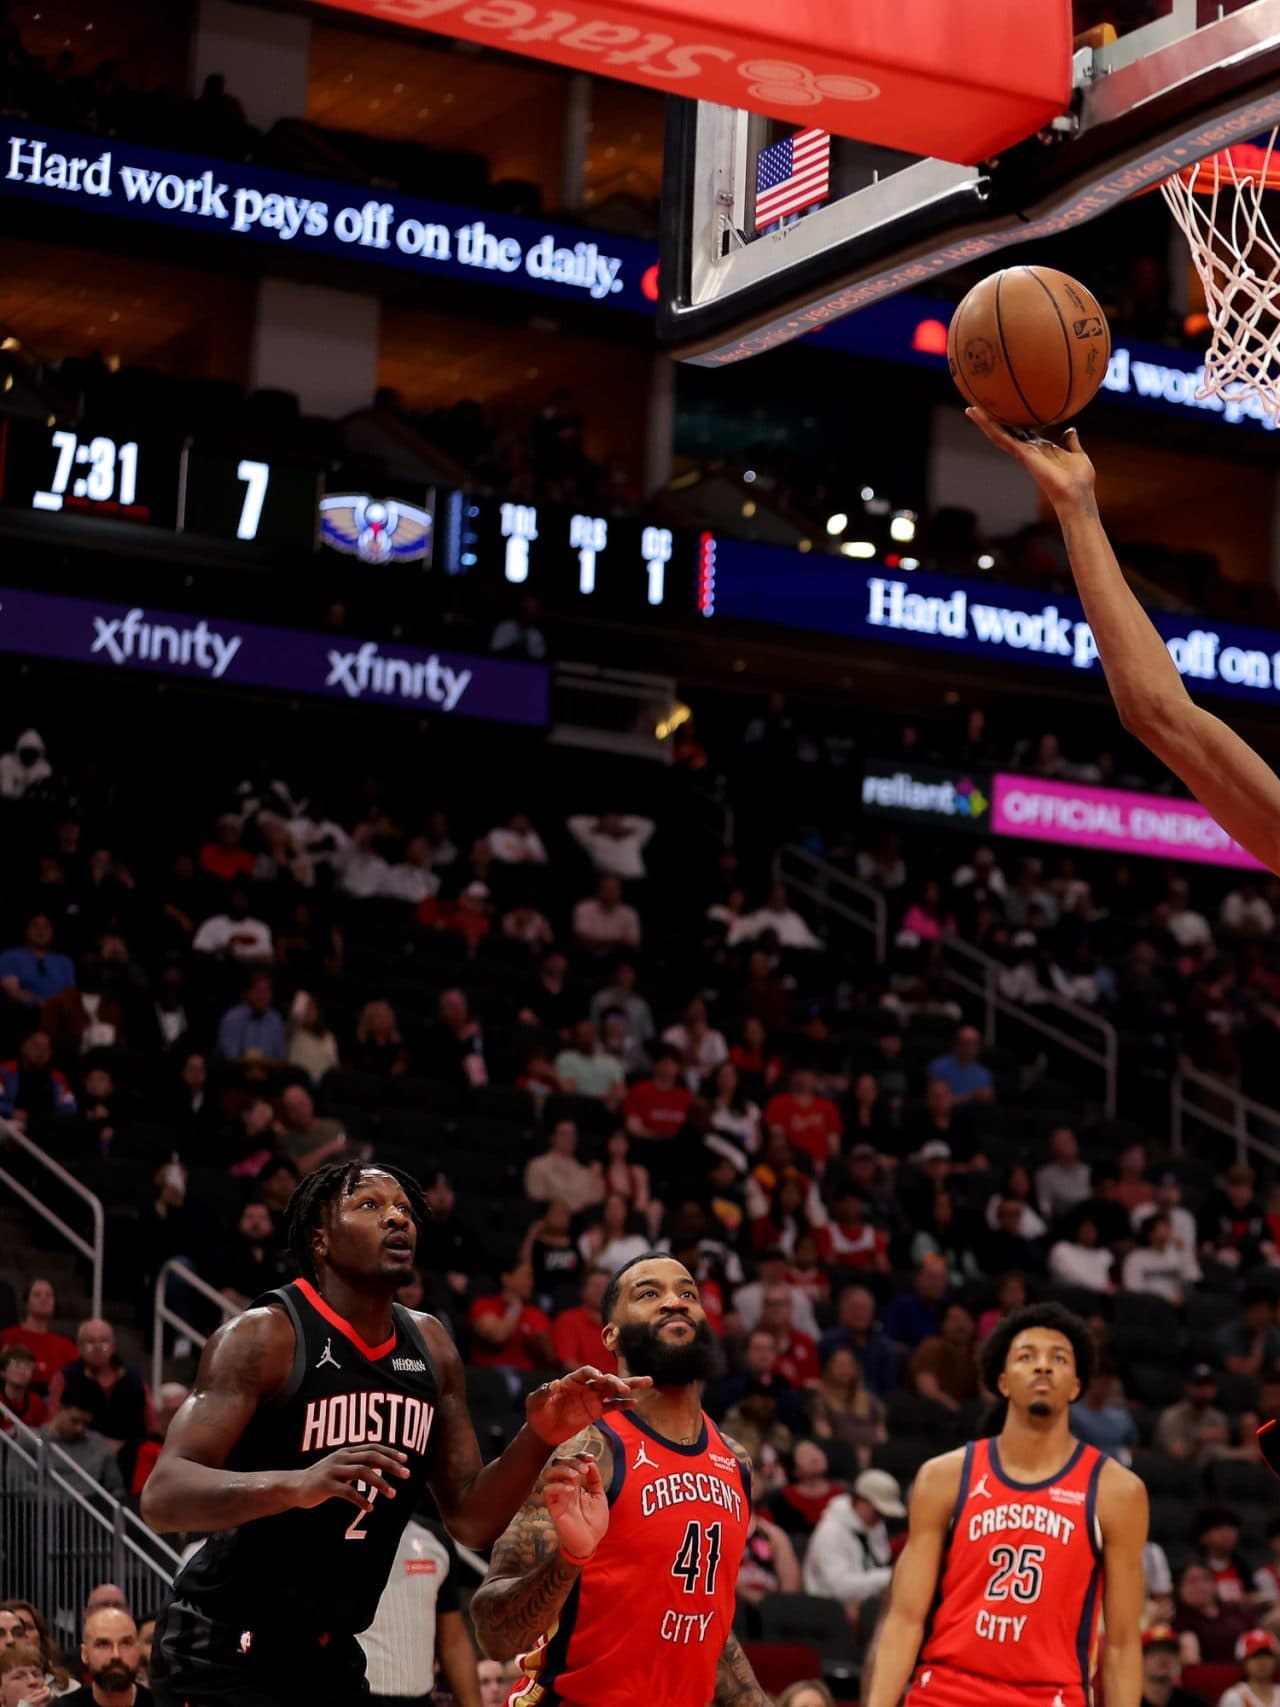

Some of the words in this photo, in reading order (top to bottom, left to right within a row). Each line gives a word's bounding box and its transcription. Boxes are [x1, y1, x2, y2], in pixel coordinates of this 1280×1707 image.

[1095, 155, 1180, 196] Turkey
[6, 136, 112, 197] Hard
[119, 167, 229, 219] work
[232, 188, 328, 240] pays
[334, 200, 394, 249] off
[396, 218, 452, 260] on
[456, 222, 521, 272] the
[525, 235, 624, 298] daily.
[51, 431, 139, 507] 7:31
[237, 460, 271, 541] 7
[867, 577, 968, 638] Hard
[969, 605, 1074, 655] work
[91, 607, 244, 678] xfinity
[326, 642, 473, 711] xfinity
[1167, 630, 1219, 680] off
[1219, 644, 1271, 690] on
[863, 774, 956, 815] reliant
[1002, 790, 1126, 838] OFFICIAL
[301, 1392, 435, 1456] HOUSTON
[344, 1467, 383, 1540] 2
[641, 1472, 742, 1523] CRESCENT
[968, 1503, 1075, 1545] CRESCENT
[671, 1520, 722, 1595] 41
[984, 1544, 1046, 1604] 25
[660, 1609, 715, 1644] CITY
[975, 1609, 1028, 1643] CITY
